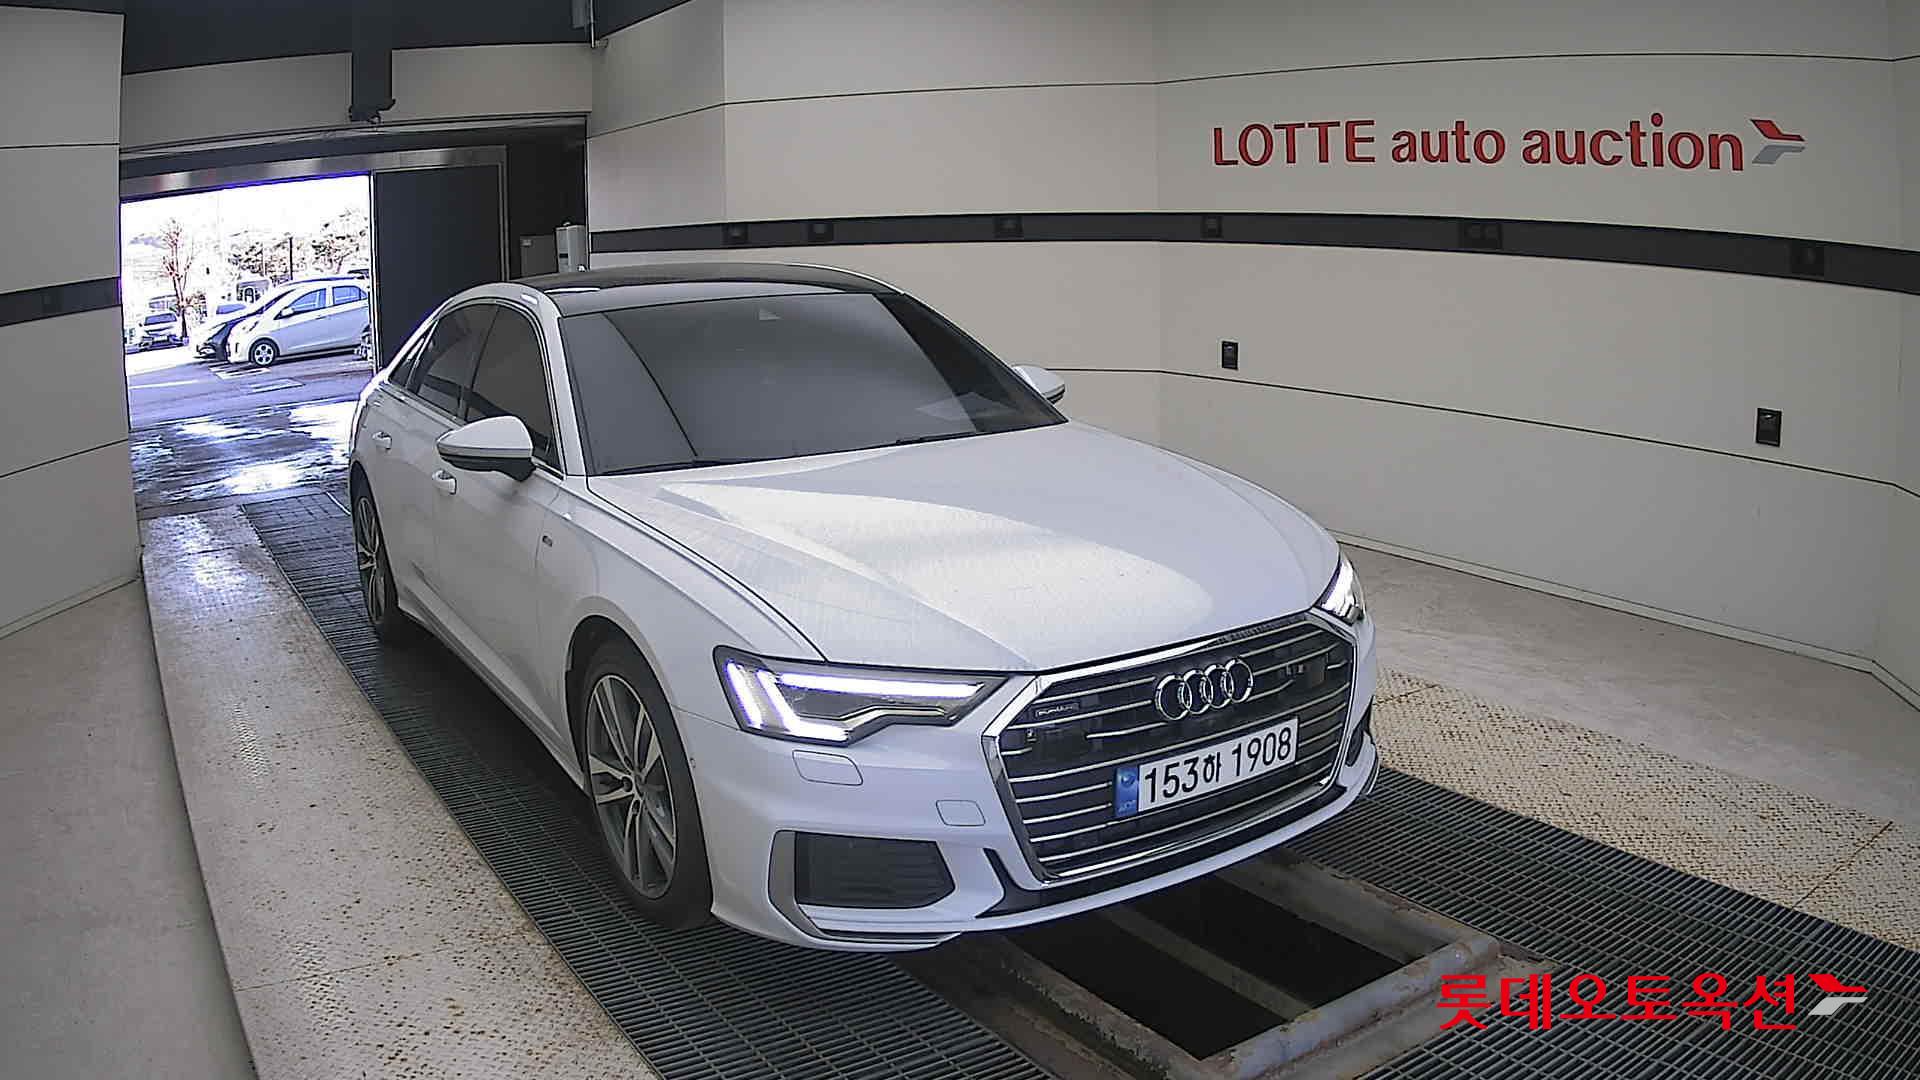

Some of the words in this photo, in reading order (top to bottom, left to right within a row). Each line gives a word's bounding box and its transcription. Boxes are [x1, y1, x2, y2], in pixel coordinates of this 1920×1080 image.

[1212, 119, 1376, 167] LOTTE
[1391, 120, 1505, 165] auto
[1521, 112, 1744, 172] auction
[1144, 751, 1222, 803] 153하
[1231, 727, 1292, 777] 1908
